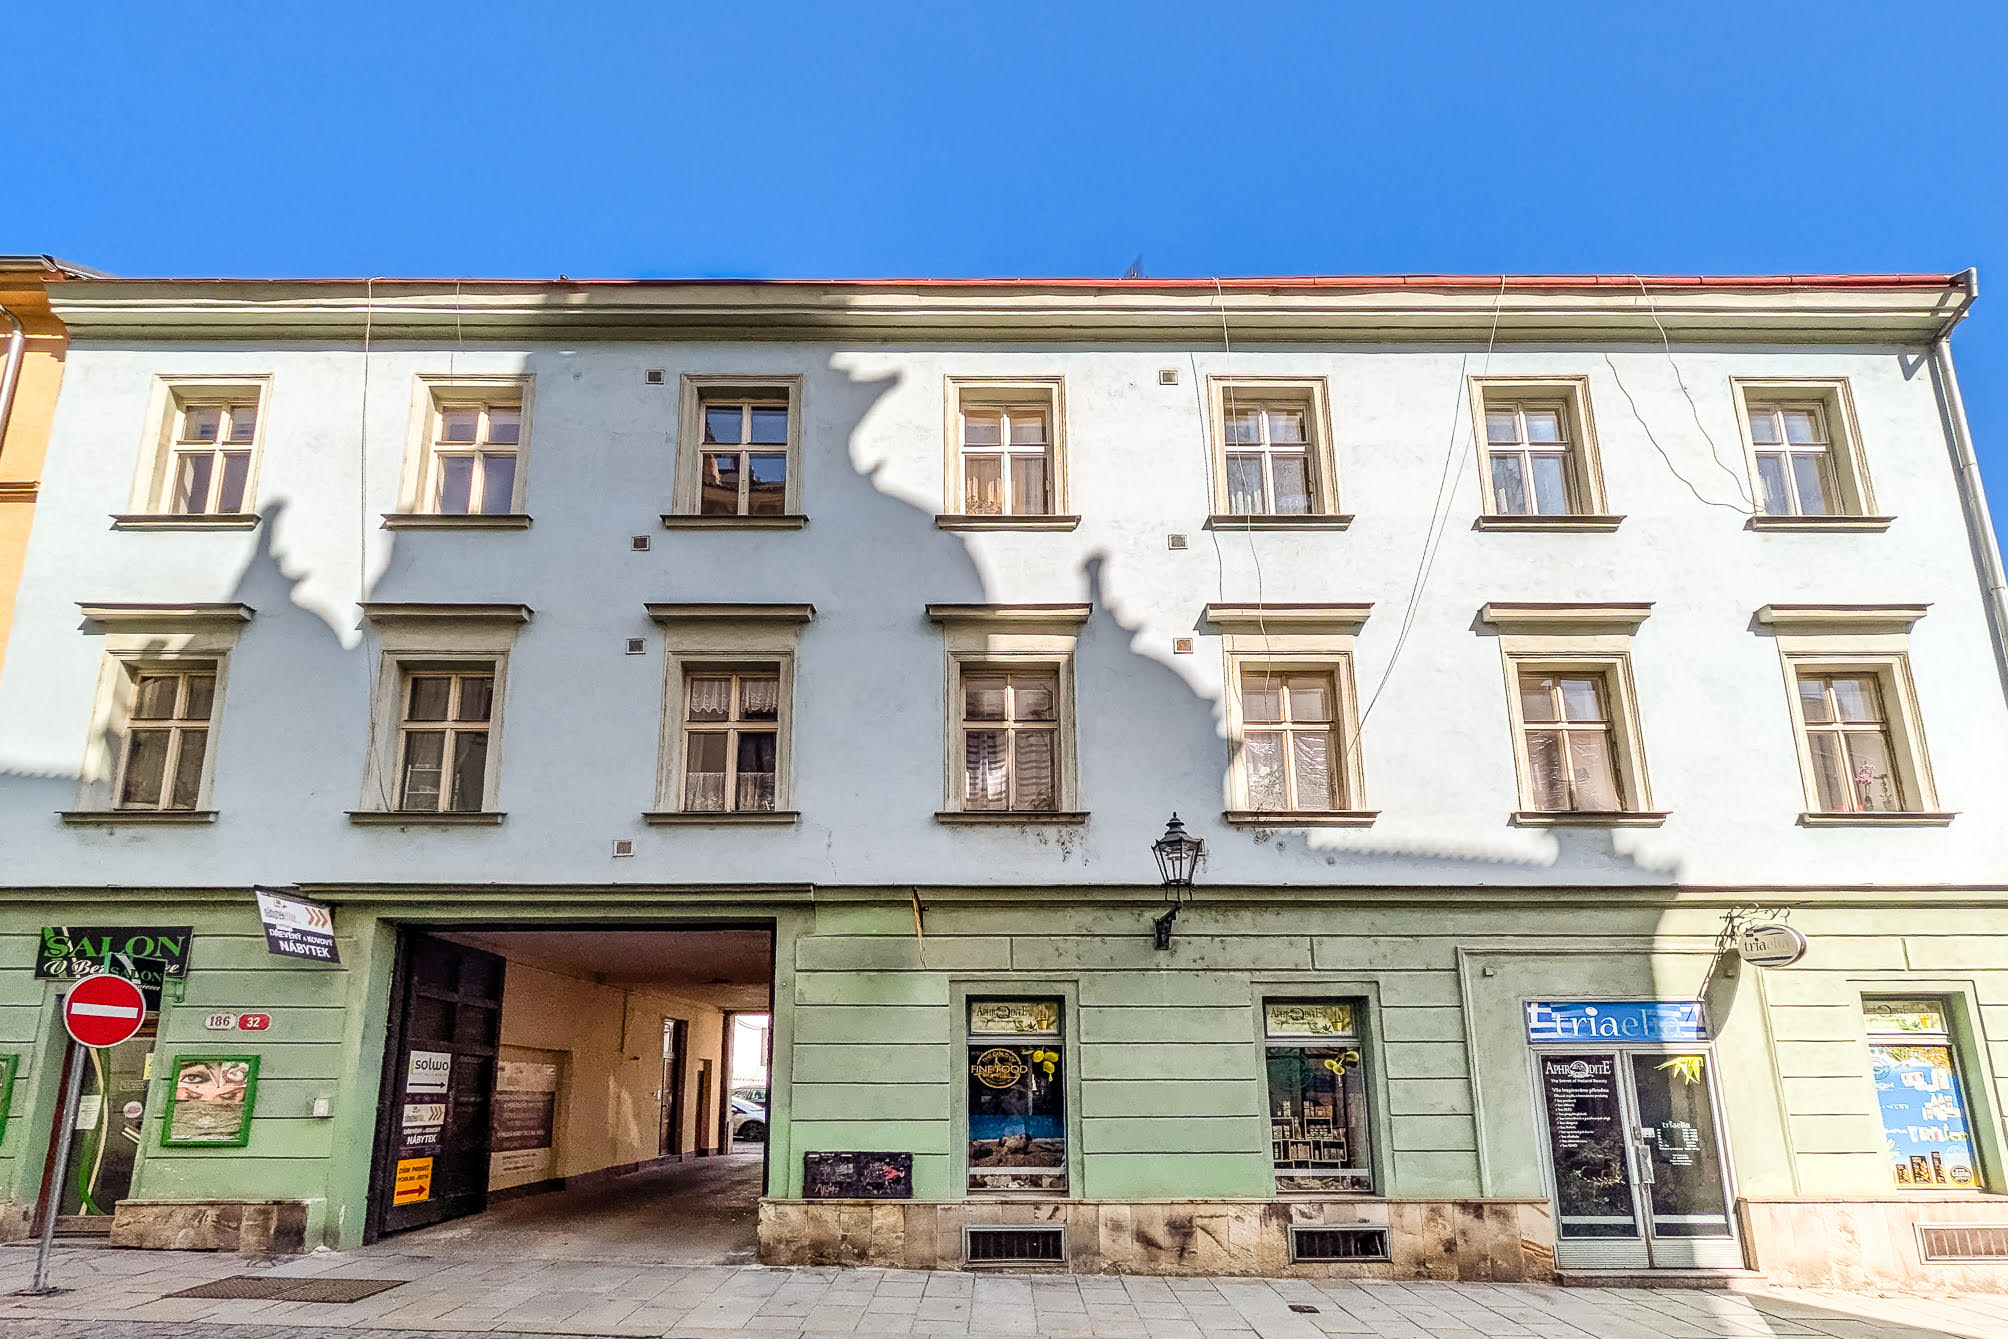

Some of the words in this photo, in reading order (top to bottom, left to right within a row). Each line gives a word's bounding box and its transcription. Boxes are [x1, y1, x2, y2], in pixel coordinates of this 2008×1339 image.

[43, 935, 186, 957] SALON
[279, 939, 331, 958] NÁBYTEK
[209, 1015, 230, 1027] 186
[247, 1017, 260, 1028] 32
[1552, 1006, 1683, 1037] triaelia
[415, 1058, 449, 1071] solwo
[971, 1065, 993, 1073] FINE
[996, 1065, 1028, 1073] FOOD
[1545, 1060, 1611, 1078] APHRODITE
[407, 1134, 437, 1145] NÁBYTEK
